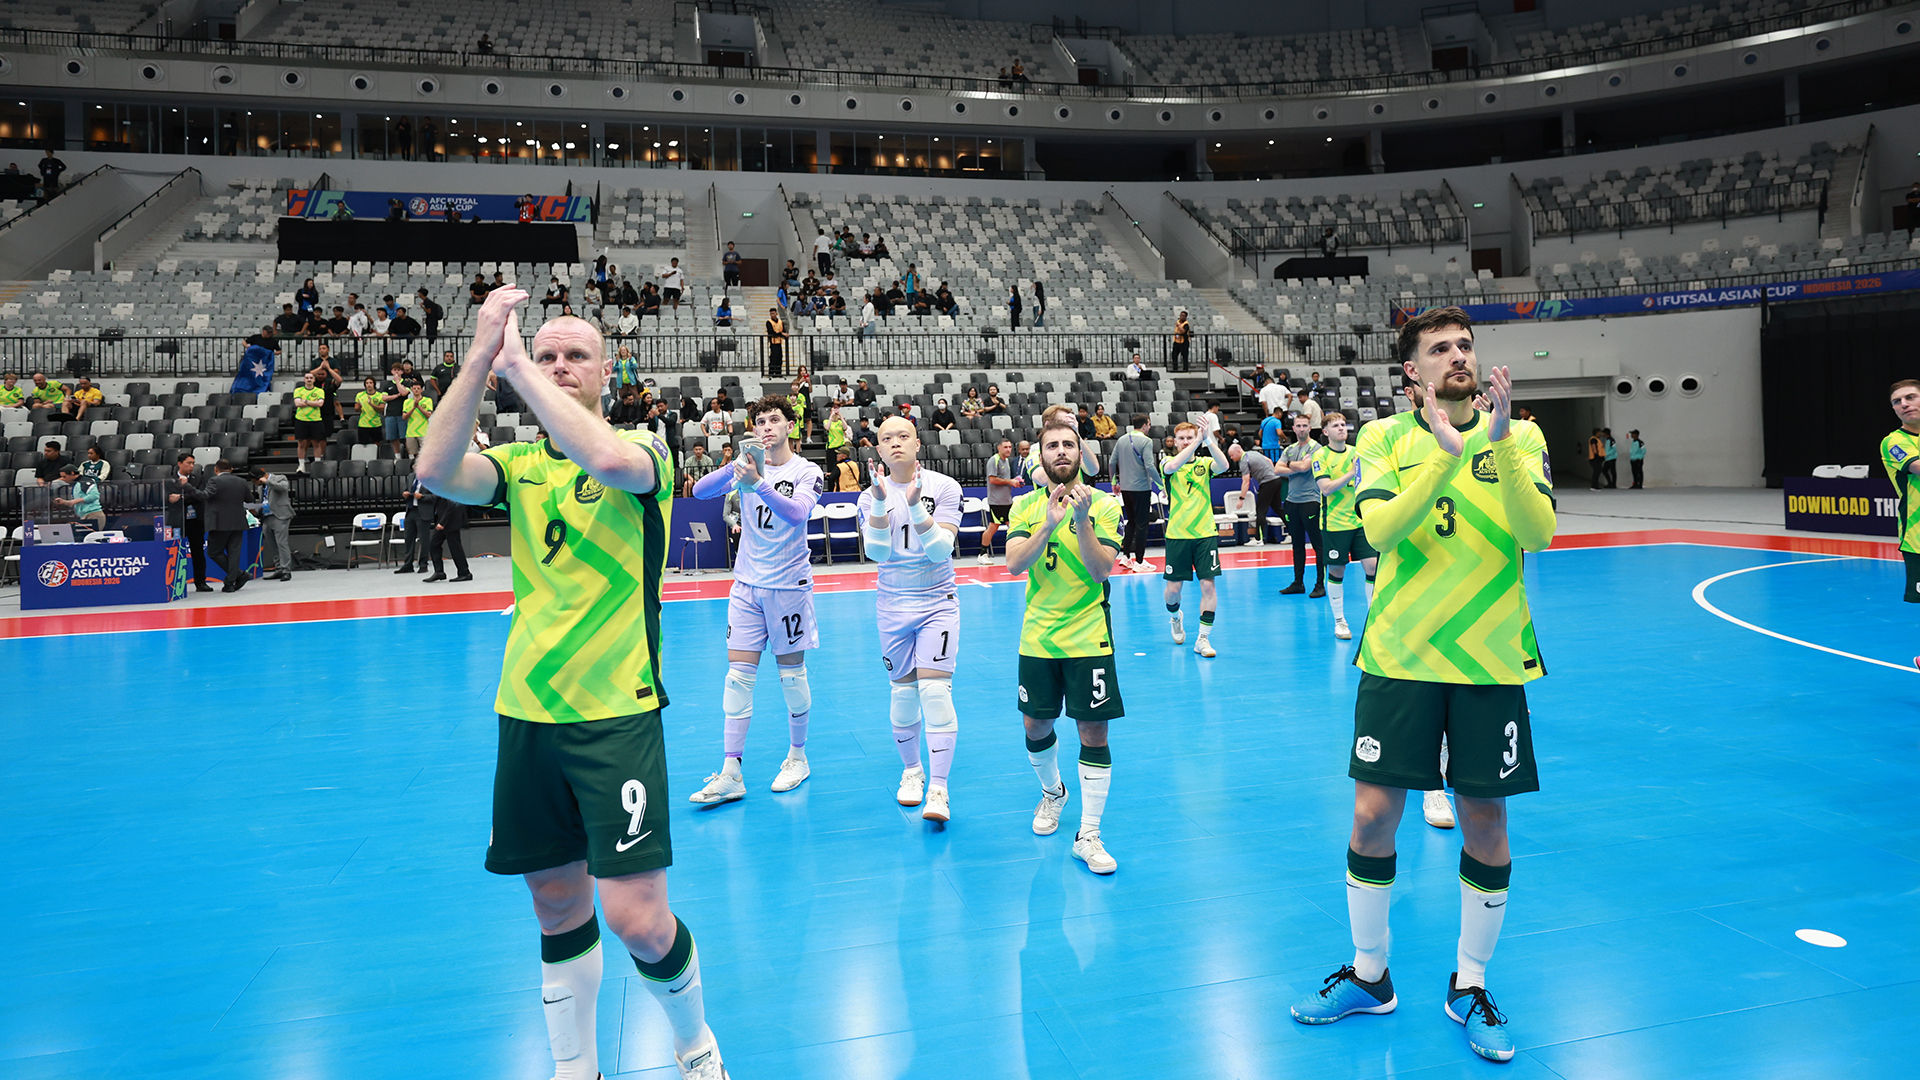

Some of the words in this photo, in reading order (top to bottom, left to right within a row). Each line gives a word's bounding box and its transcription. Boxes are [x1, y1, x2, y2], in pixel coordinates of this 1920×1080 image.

[1663, 293, 1717, 306] FUTSAL
[1718, 289, 1762, 301] ASIAN
[1766, 285, 1797, 298] CUP
[1803, 280, 1852, 294] INDONESIA
[1854, 278, 1882, 289] 2026
[1187, 481, 1193, 494] 7
[755, 505, 774, 530] 12
[1435, 496, 1456, 539] 3
[1788, 495, 1870, 516] DOWNLOAD
[541, 519, 567, 567] 9
[901, 523, 910, 550] 1
[71, 559, 98, 569] AFC
[100, 557, 149, 568] FUTSAL
[1045, 541, 1059, 572] 5
[1210, 550, 1217, 566] 7
[71, 568, 111, 578] ASIAN
[113, 566, 141, 577] CUP
[71, 578, 102, 586] INDONESIA
[104, 577, 120, 585] 2026
[782, 613, 804, 638] 12
[940, 630, 949, 656] 1
[1092, 667, 1106, 700] 5
[1503, 721, 1518, 767] 3
[621, 779, 647, 836] 9
